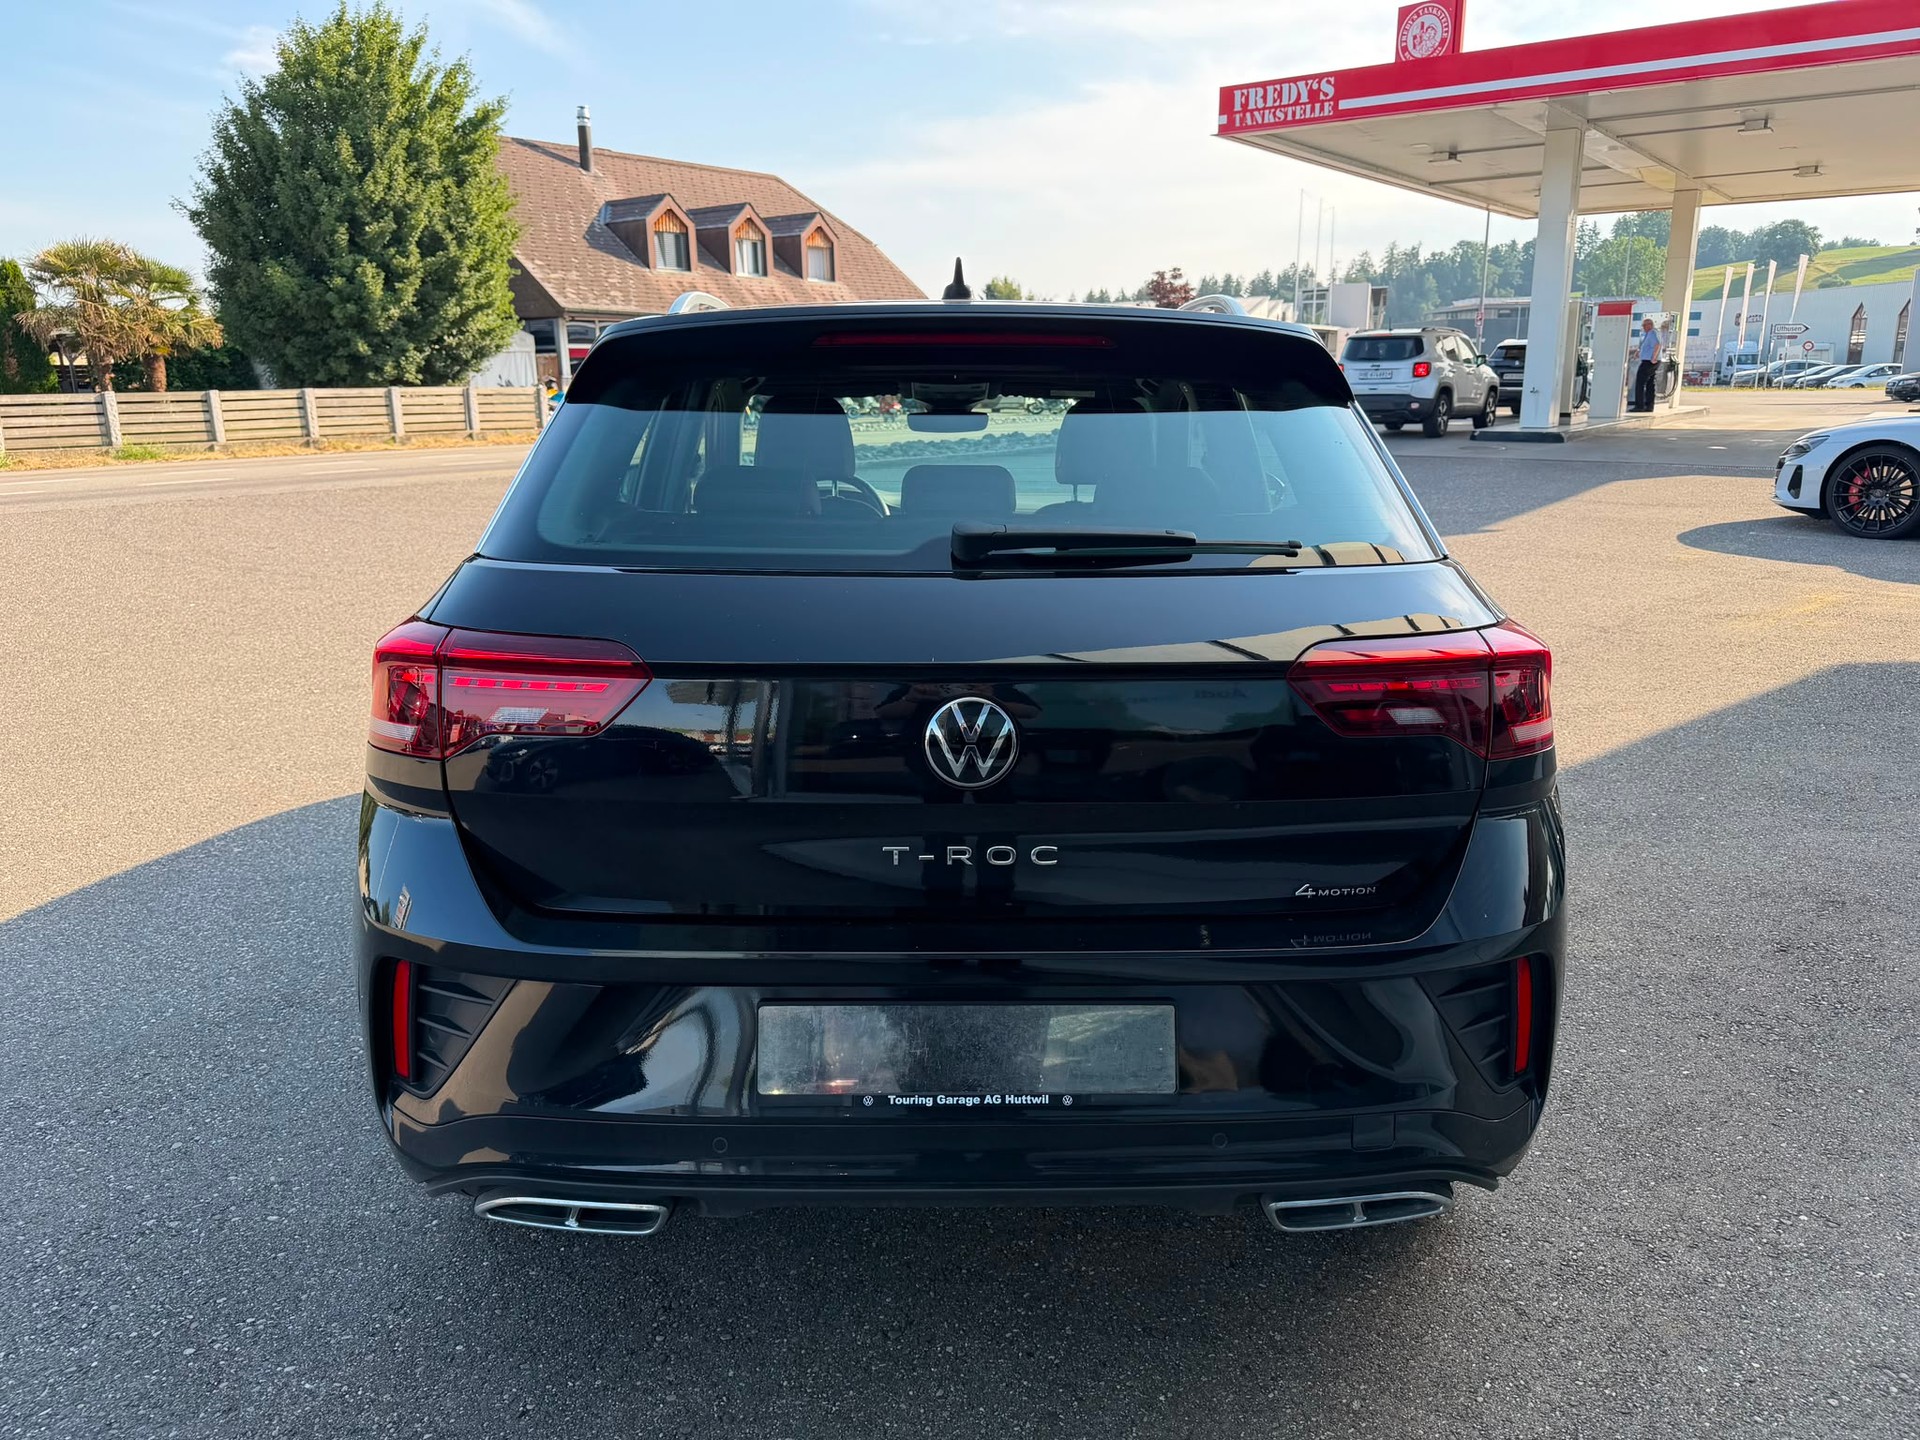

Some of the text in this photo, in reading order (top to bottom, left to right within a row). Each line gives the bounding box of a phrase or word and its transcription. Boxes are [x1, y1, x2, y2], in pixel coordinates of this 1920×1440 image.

[1418, 6, 1449, 39] TANKSTELLE
[1234, 101, 1334, 128] TANKSTELLE
[882, 845, 1058, 866] T-ROC
[888, 1094, 1050, 1107] Touring Garage AG Huttwil
